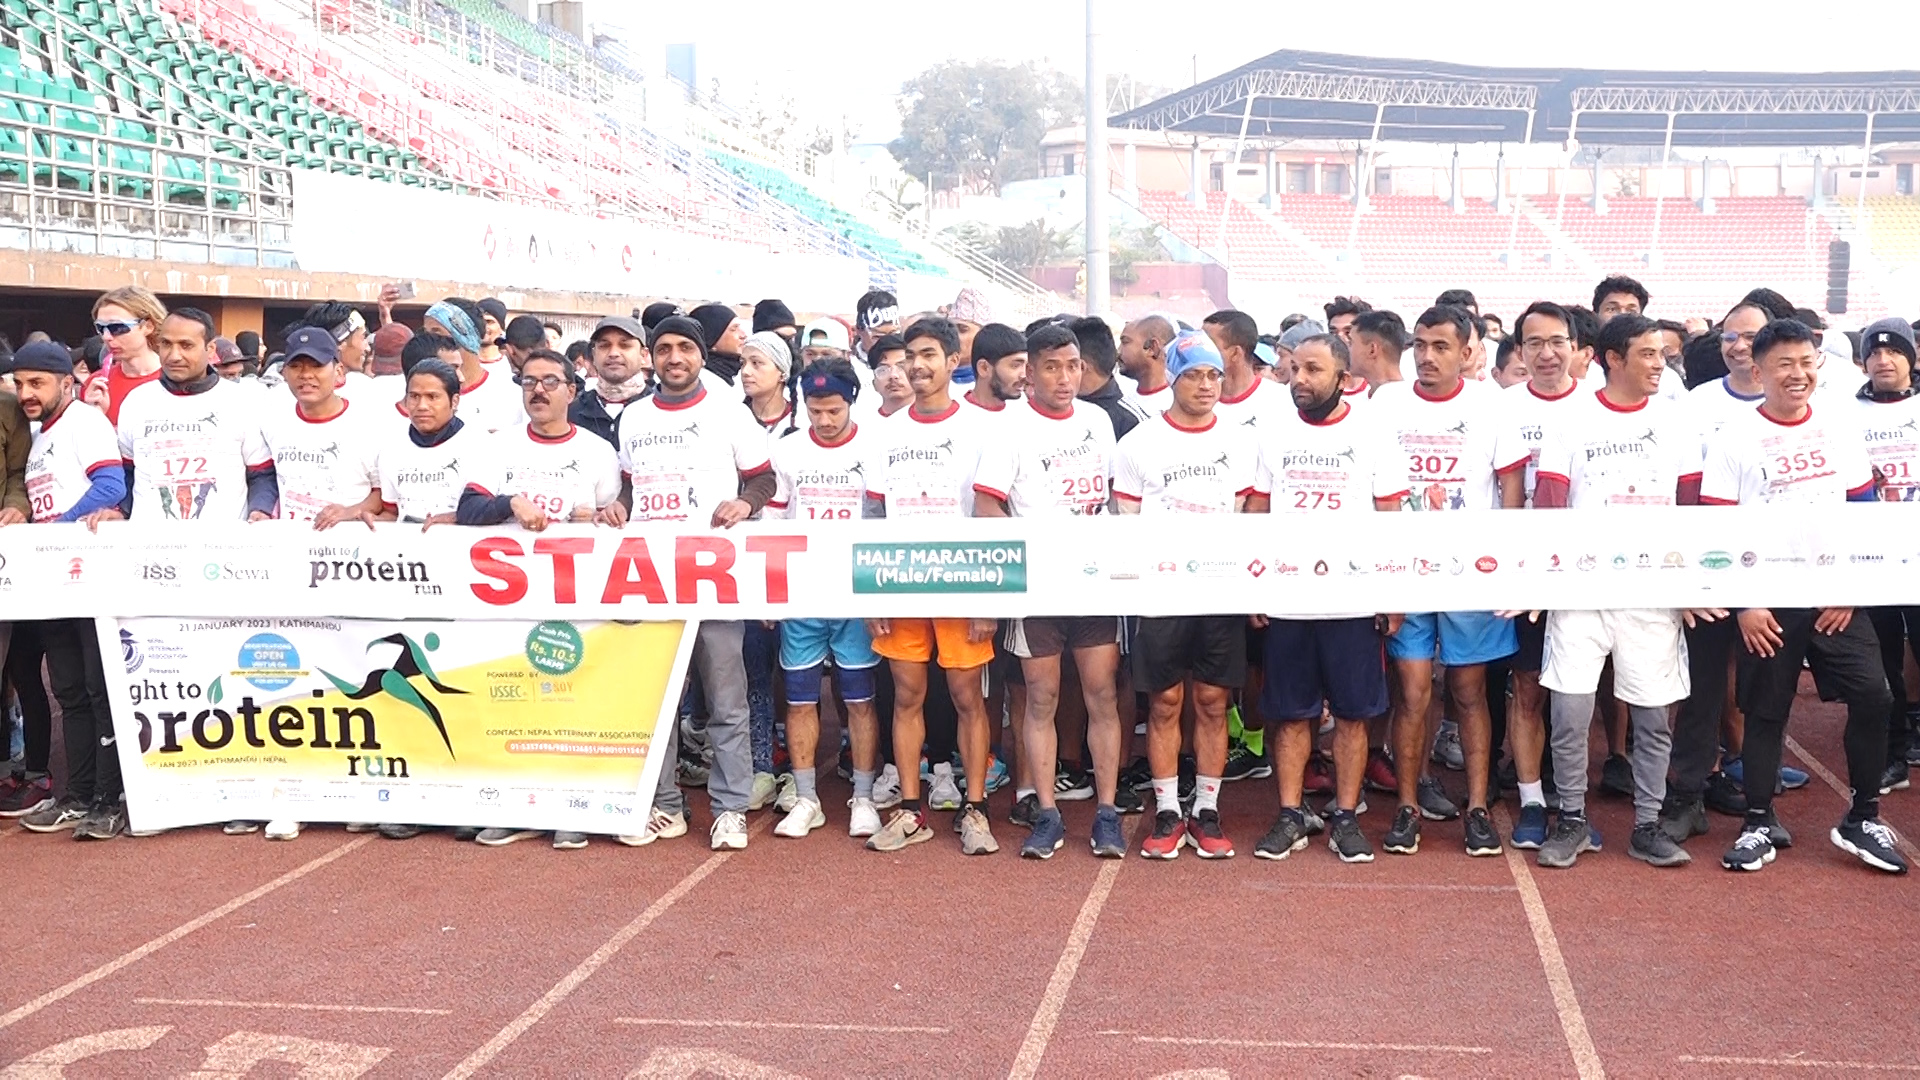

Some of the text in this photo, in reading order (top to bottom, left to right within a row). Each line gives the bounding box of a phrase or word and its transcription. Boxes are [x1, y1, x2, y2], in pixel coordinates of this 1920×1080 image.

[631, 434, 683, 453] protein
[1586, 443, 1644, 461] protein
[163, 457, 208, 476] 172
[277, 450, 325, 464] protein
[889, 449, 938, 467] protein
[1282, 453, 1340, 469] protein
[1409, 454, 1458, 474] 307
[1775, 449, 1826, 475] 355
[398, 470, 445, 485] protein
[1062, 475, 1104, 496] 290
[1163, 465, 1217, 487] protein
[640, 493, 681, 513] 308
[1294, 491, 1341, 510] 275
[308, 546, 351, 558] right to
[856, 547, 1022, 567] HALF MARATHON
[308, 553, 430, 588] protein
[469, 535, 808, 606] START
[875, 566, 1004, 588] (Male/Female)
[414, 584, 443, 595] run
[179, 619, 342, 632] 21 JANUARY 2023 KATHMANDU
[254, 651, 284, 660] OPEN
[486, 671, 525, 679] POWERED
[176, 681, 202, 700] to
[490, 684, 521, 698] USSEC
[528, 729, 551, 737] NEPAL
[554, 729, 598, 739] VETERINARY
[347, 755, 410, 778] run
